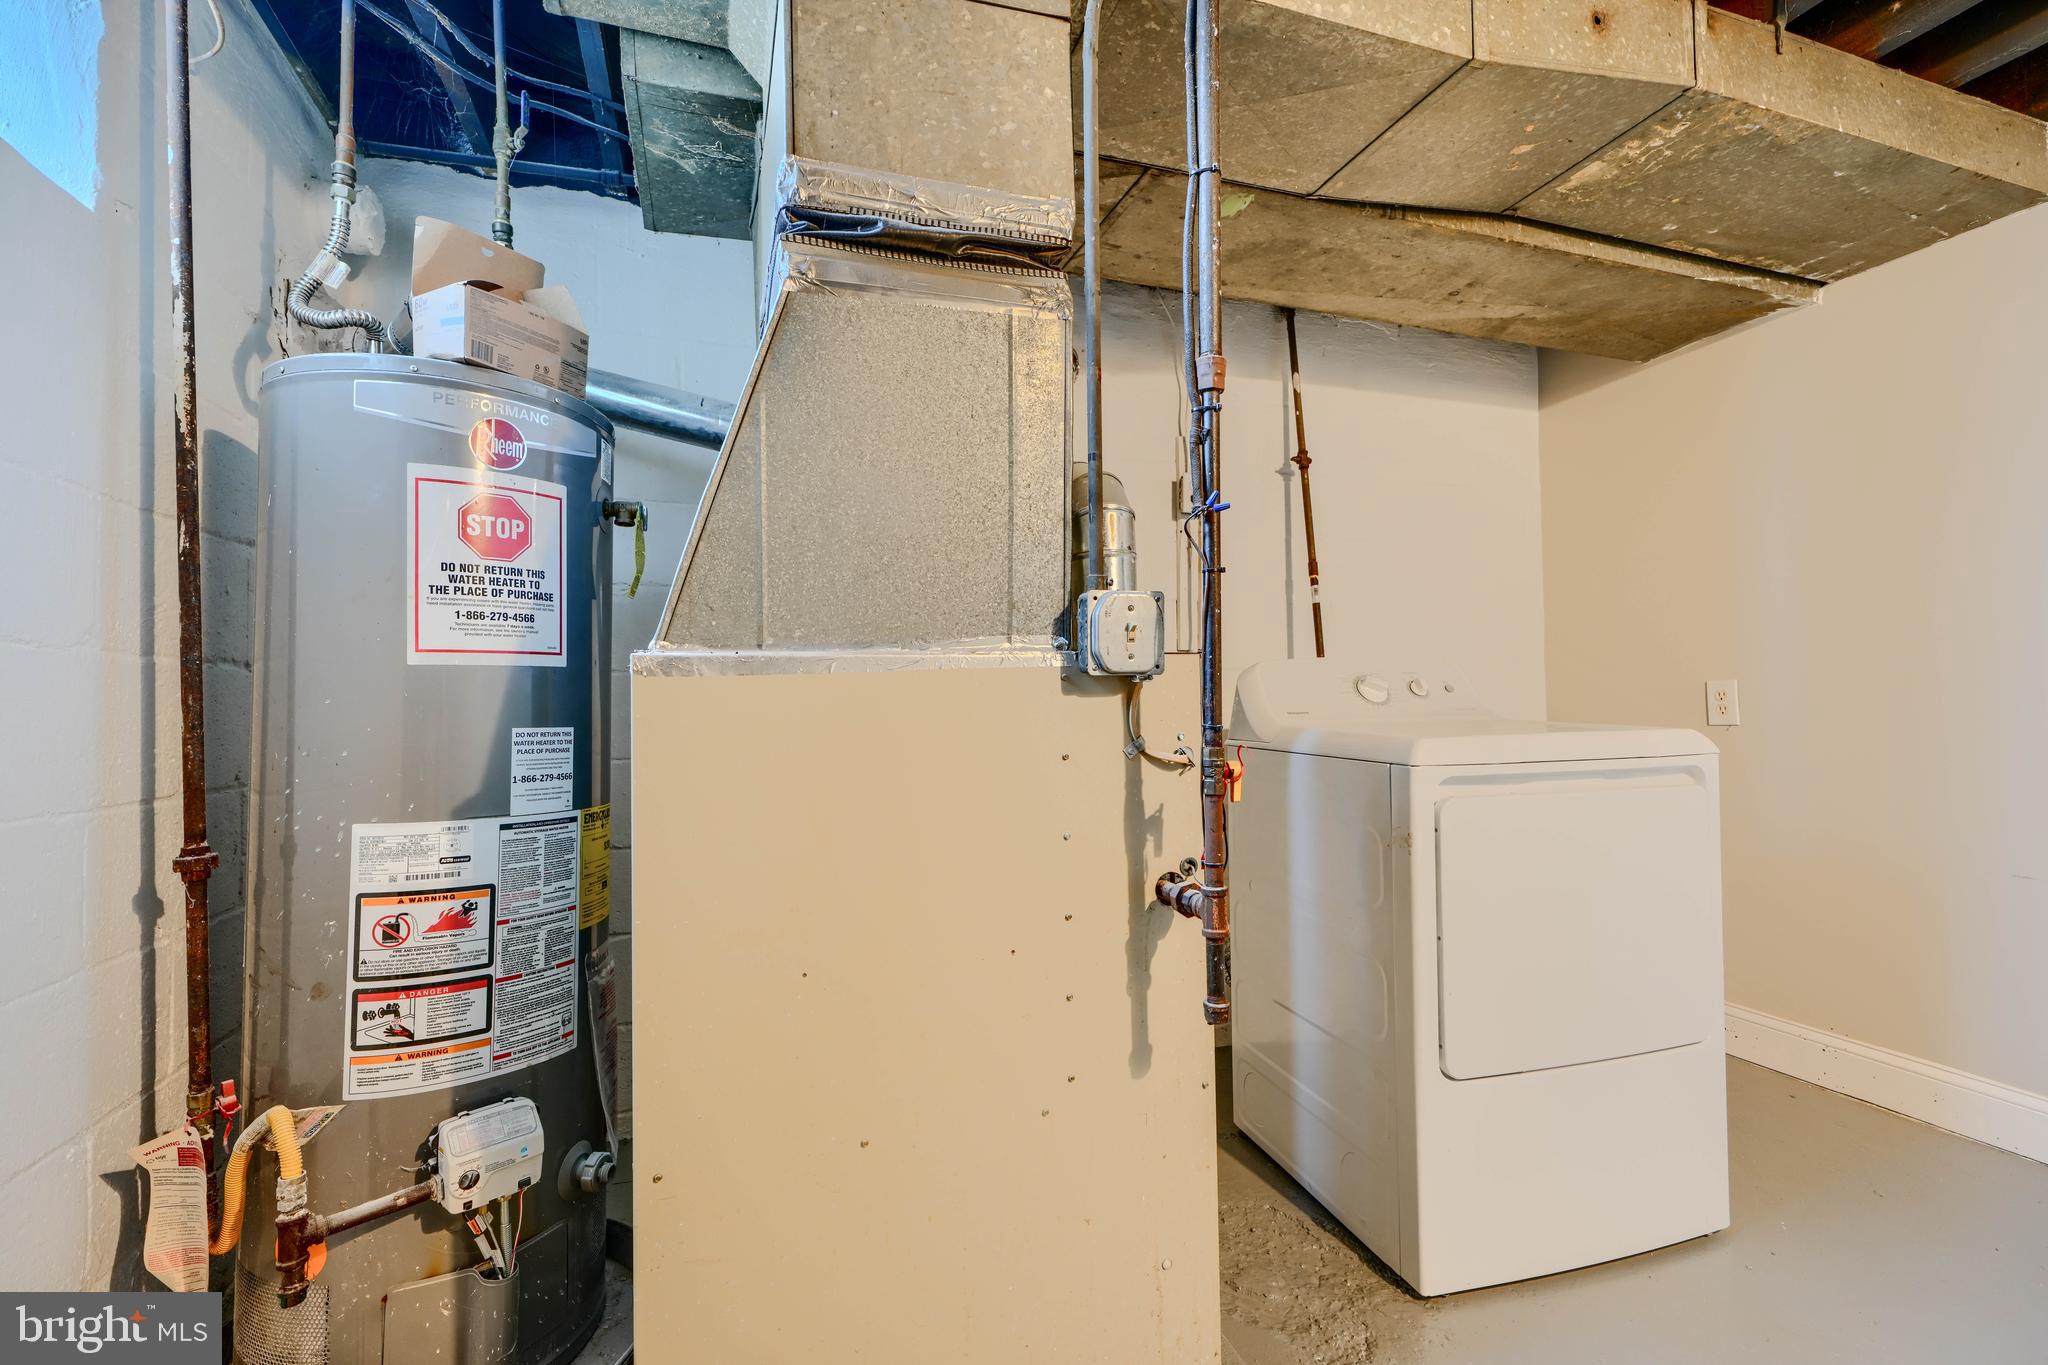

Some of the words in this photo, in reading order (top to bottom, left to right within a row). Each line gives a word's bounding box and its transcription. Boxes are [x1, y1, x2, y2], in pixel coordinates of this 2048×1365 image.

[477, 418, 523, 461] Rheem
[466, 513, 525, 540] STOP
[440, 562, 456, 572] DO
[460, 564, 480, 574] NOT
[484, 566, 522, 577] RETURN
[526, 569, 546, 580] THIS
[448, 574, 486, 585] WATER
[488, 577, 526, 588] HEATER
[528, 580, 540, 590] TO
[428, 584, 450, 595] THE
[454, 586, 488, 597] PLACE
[491, 588, 504, 598] OF
[508, 590, 554, 602] PURCHASE
[455, 610, 535, 623] 1-866-279-4566
[512, 772, 572, 784] 1-866-279-4566
[408, 894, 456, 903] WARNING
[410, 987, 449, 997] DANGER
[407, 1048, 448, 1060] WARNING
[144, 1141, 180, 1156] WARNING
